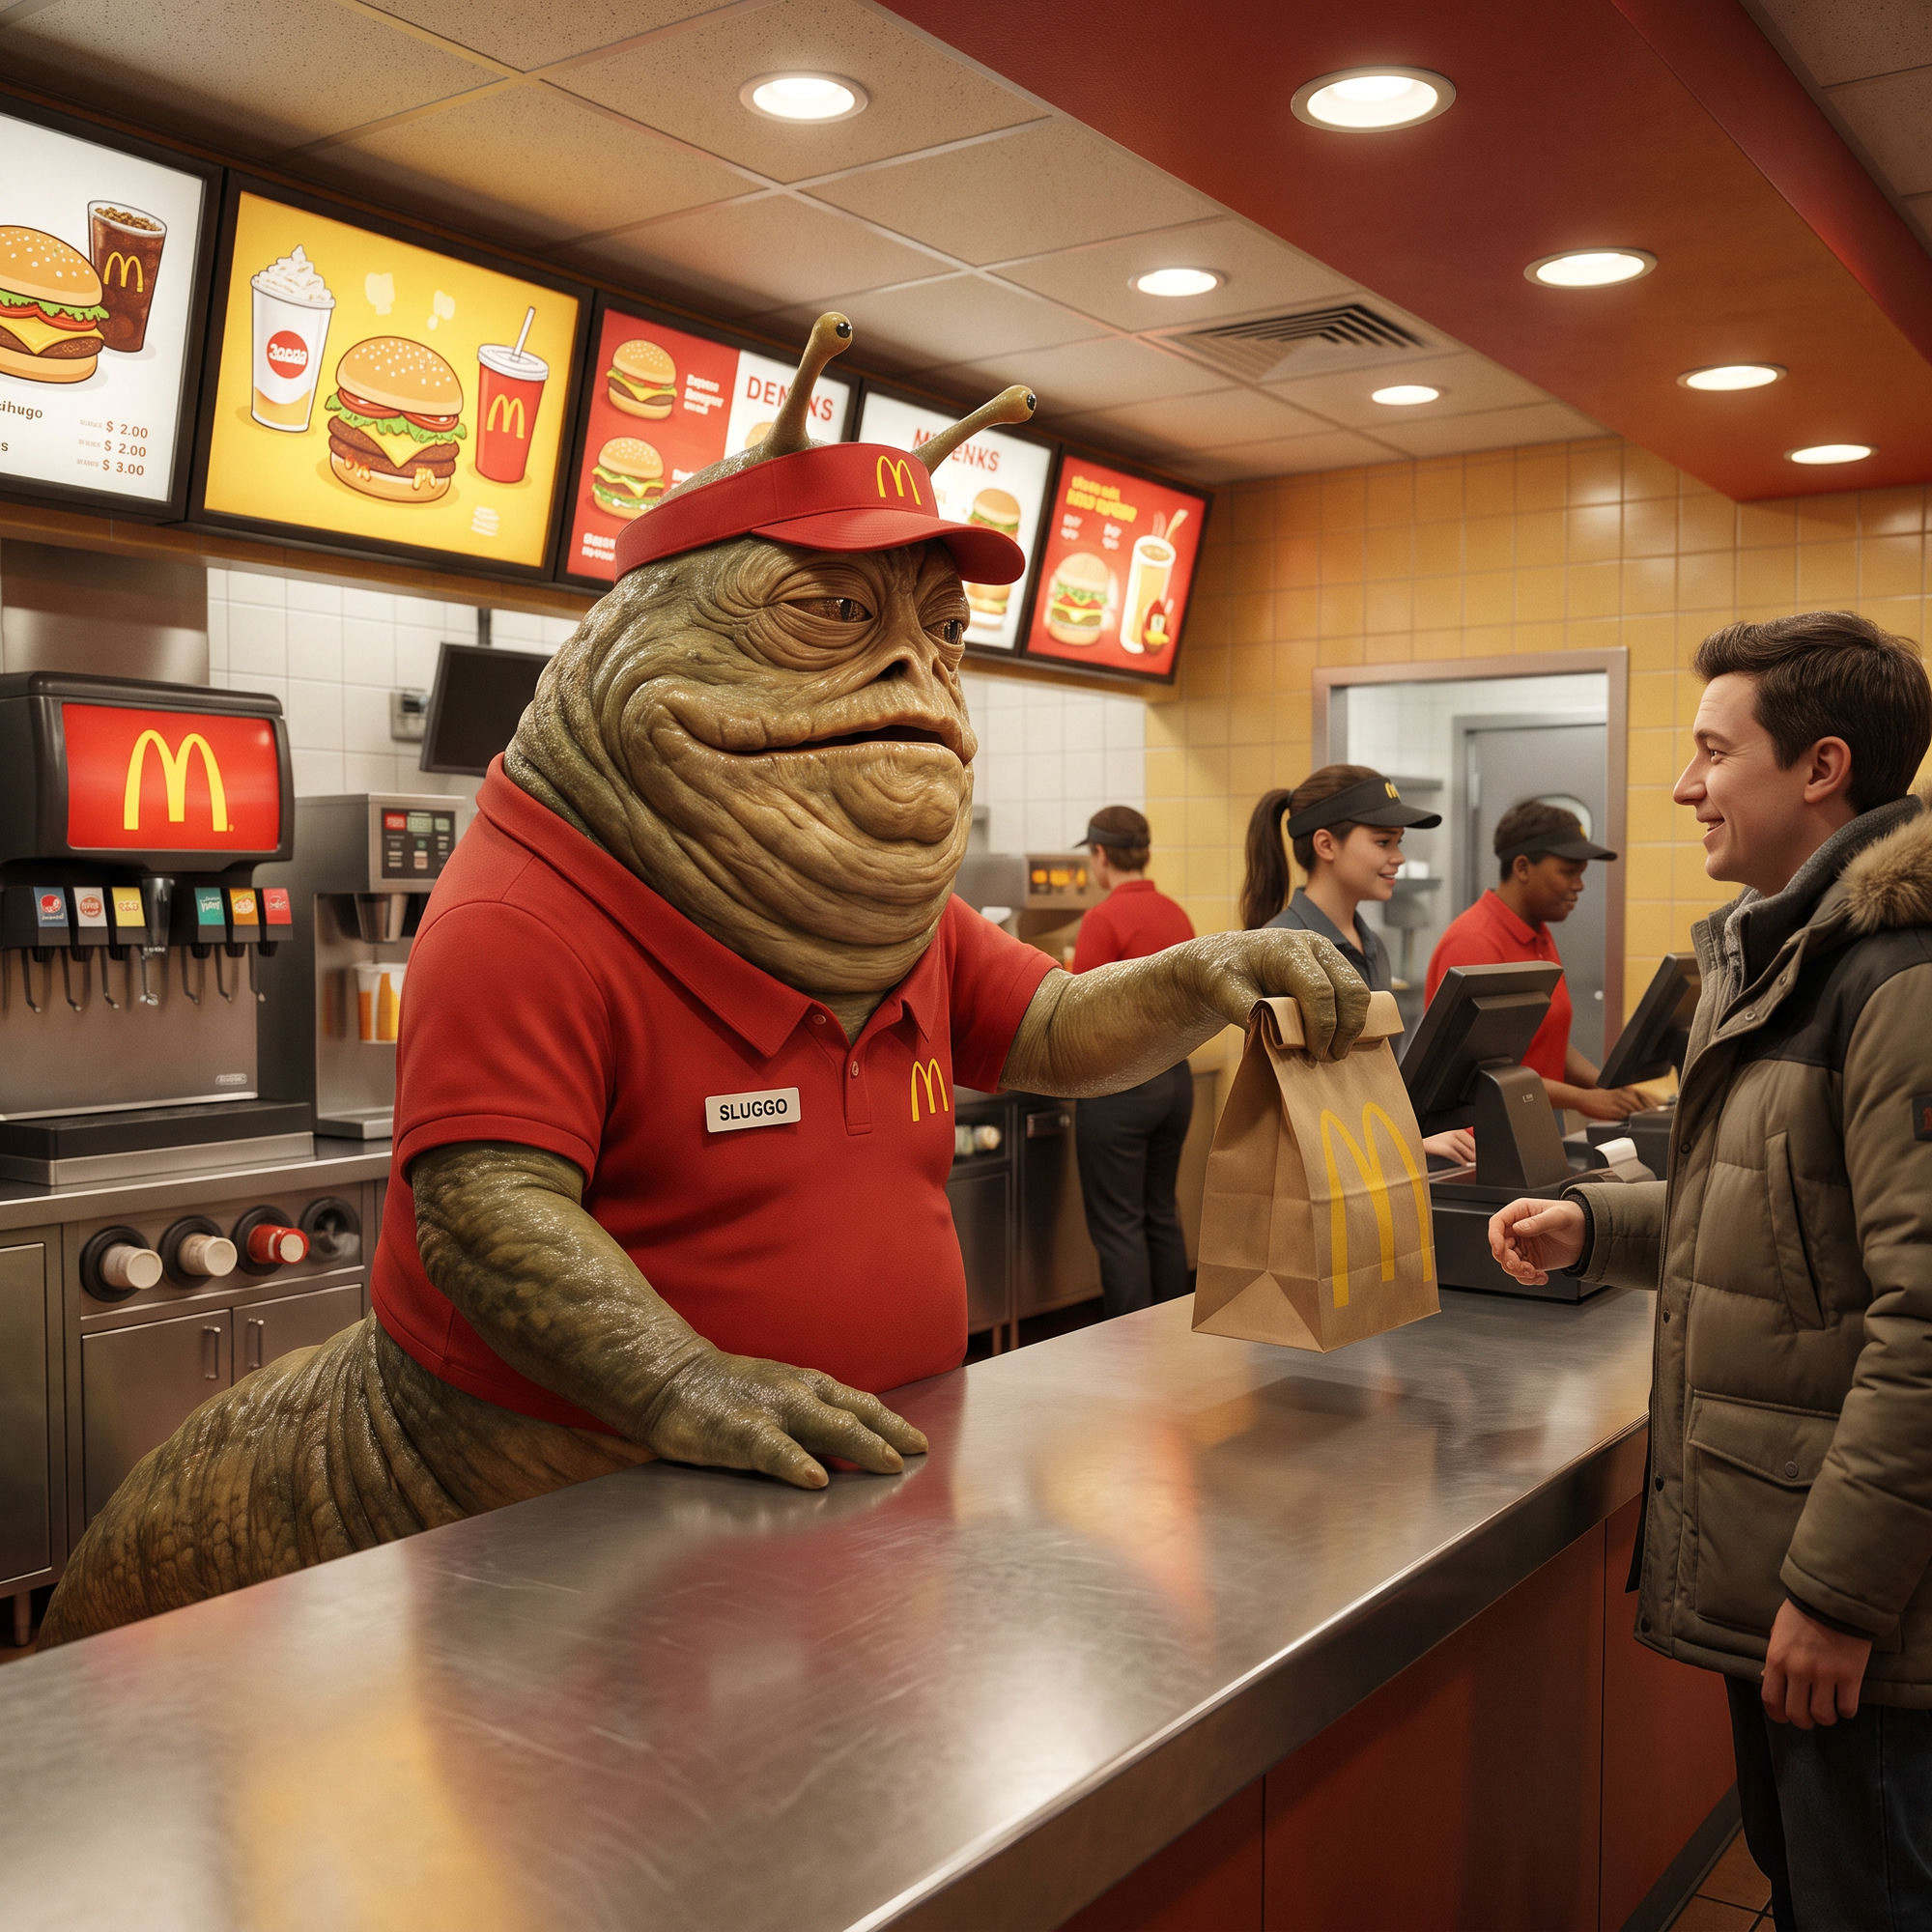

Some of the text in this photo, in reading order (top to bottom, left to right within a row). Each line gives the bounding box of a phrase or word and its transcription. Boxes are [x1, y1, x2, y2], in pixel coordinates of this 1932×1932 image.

[0, 400, 43, 420] ihugo
[105, 420, 114, 433] $
[120, 423, 149, 439] 2.00
[103, 440, 112, 451] $
[118, 442, 147, 457] 2.00
[101, 459, 110, 471] $
[116, 461, 145, 476] 3.00
[719, 1097, 788, 1122] SLUGGO
